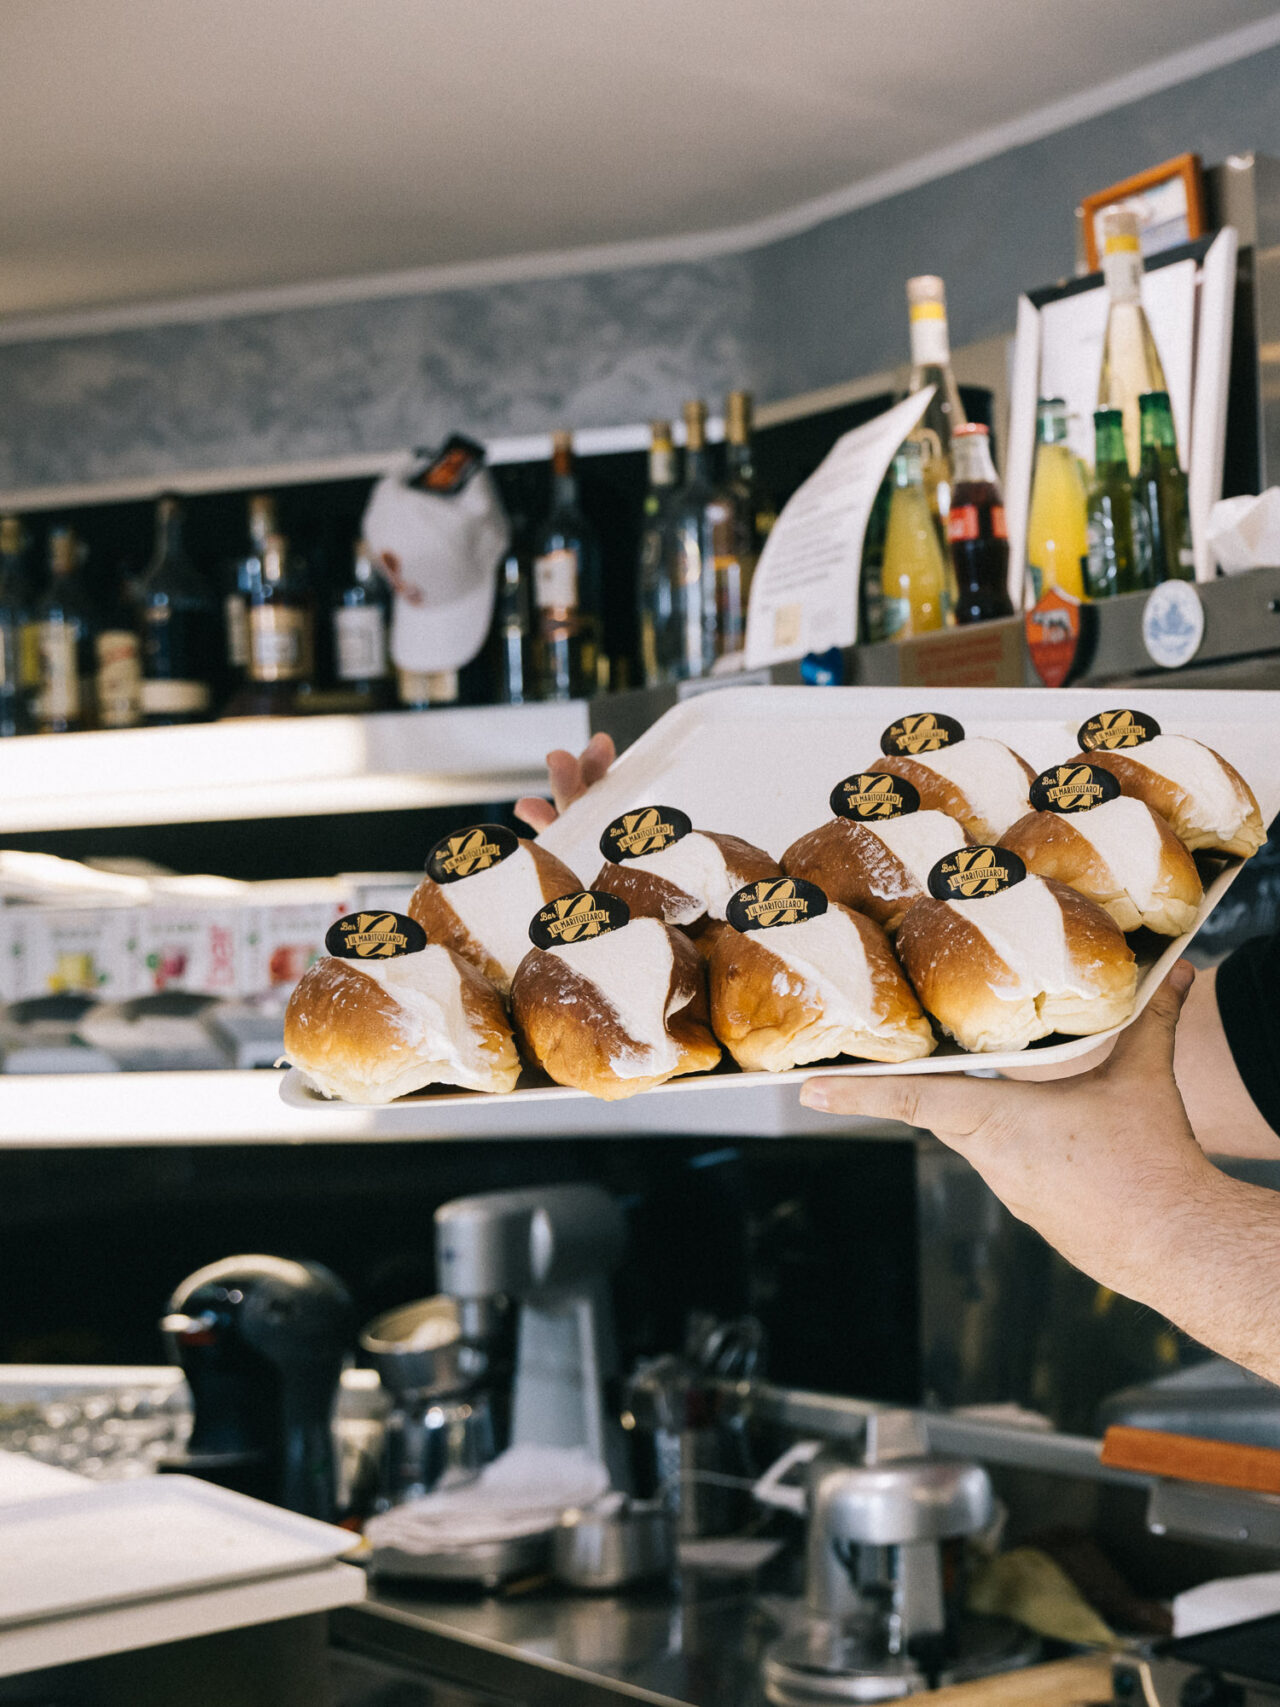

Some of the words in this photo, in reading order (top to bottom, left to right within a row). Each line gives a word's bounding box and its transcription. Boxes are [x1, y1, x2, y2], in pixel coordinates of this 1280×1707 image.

[1042, 776, 1057, 786] Bar
[1060, 785, 1098, 795] MARITOZZARO
[941, 863, 957, 873] Bar
[960, 868, 1003, 882] MARITOZZARO
[739, 892, 756, 902] Bar
[759, 900, 802, 912] MARITOZZARO
[540, 912, 557, 922] Bar
[560, 911, 604, 929] MARITOZZARO
[340, 921, 356, 931] Bar
[358, 933, 401, 943] MARITOZZARO
